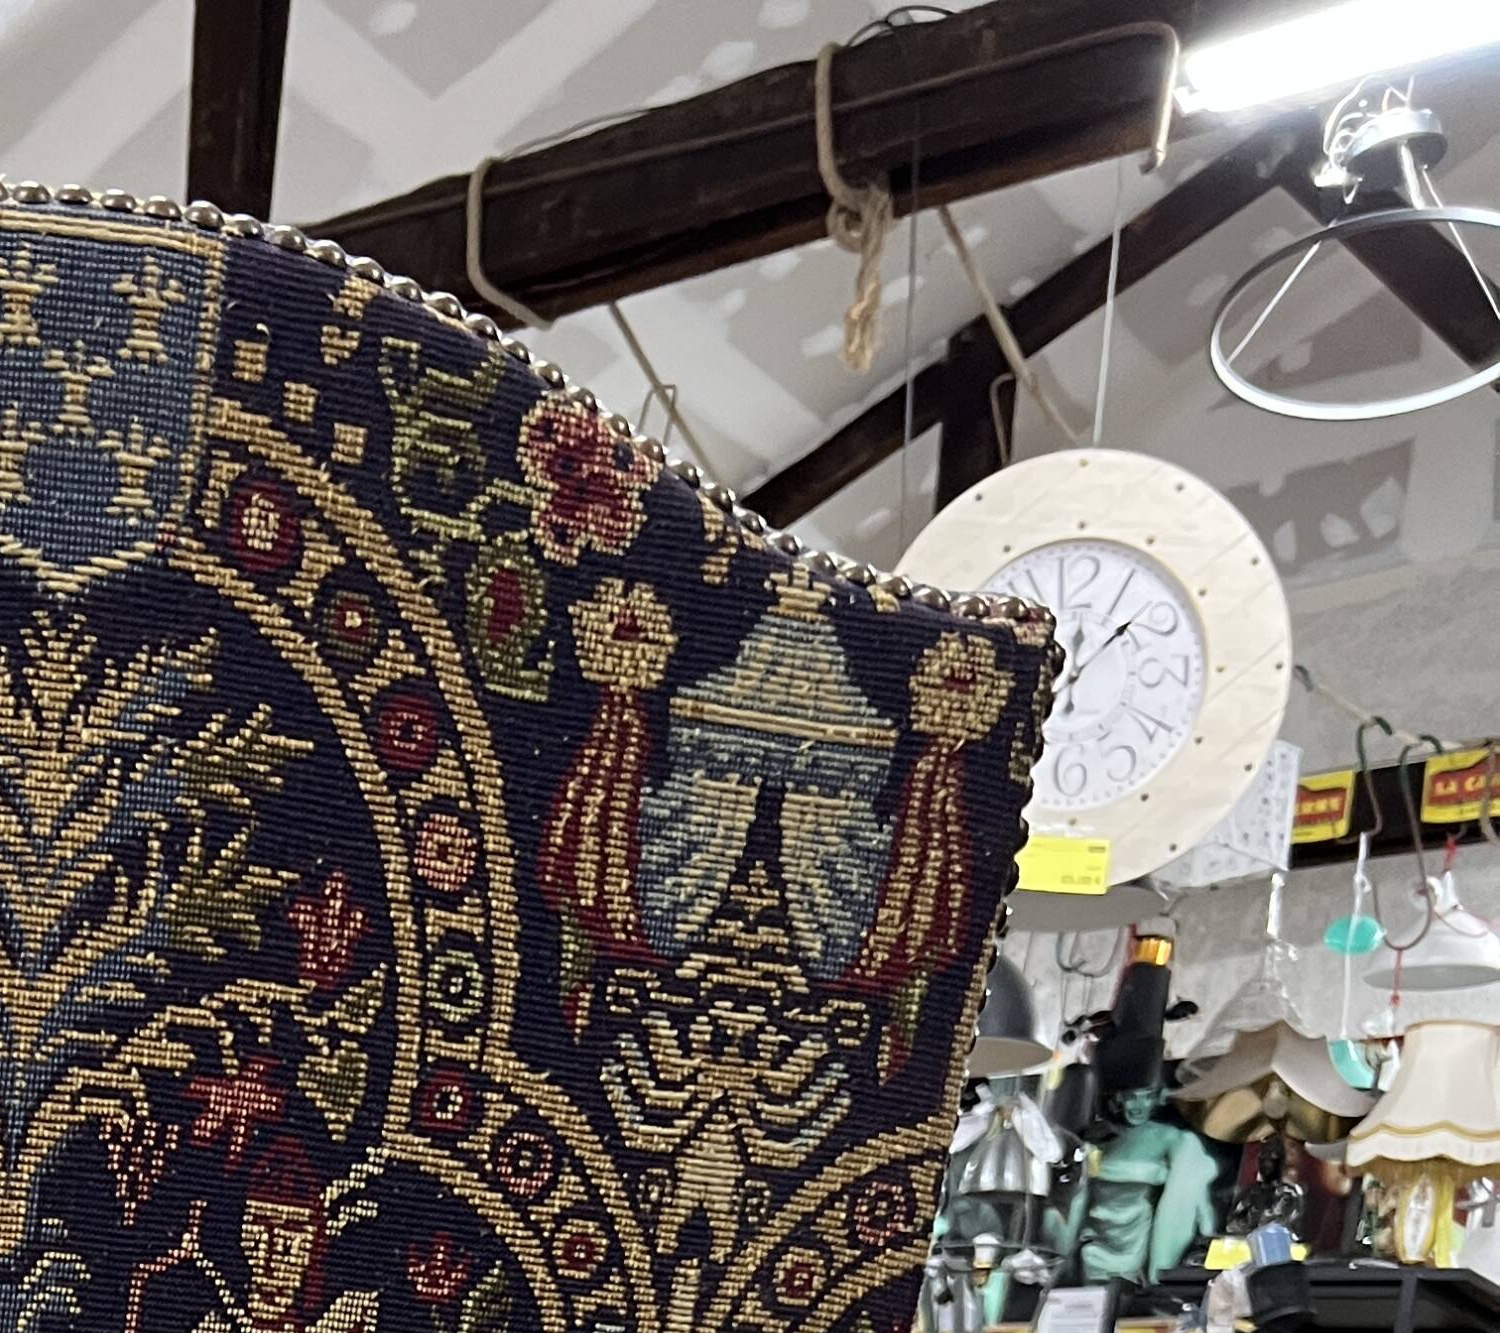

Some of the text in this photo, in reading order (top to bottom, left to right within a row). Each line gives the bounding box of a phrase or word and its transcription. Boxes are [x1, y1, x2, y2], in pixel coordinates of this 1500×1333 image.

[1059, 555, 1101, 611] 12
[1129, 601, 1179, 651] 2
[1138, 653, 1190, 689] 3
[1121, 701, 1174, 744] 4
[1053, 744, 1088, 797] 6
[1097, 730, 1137, 783] 5
